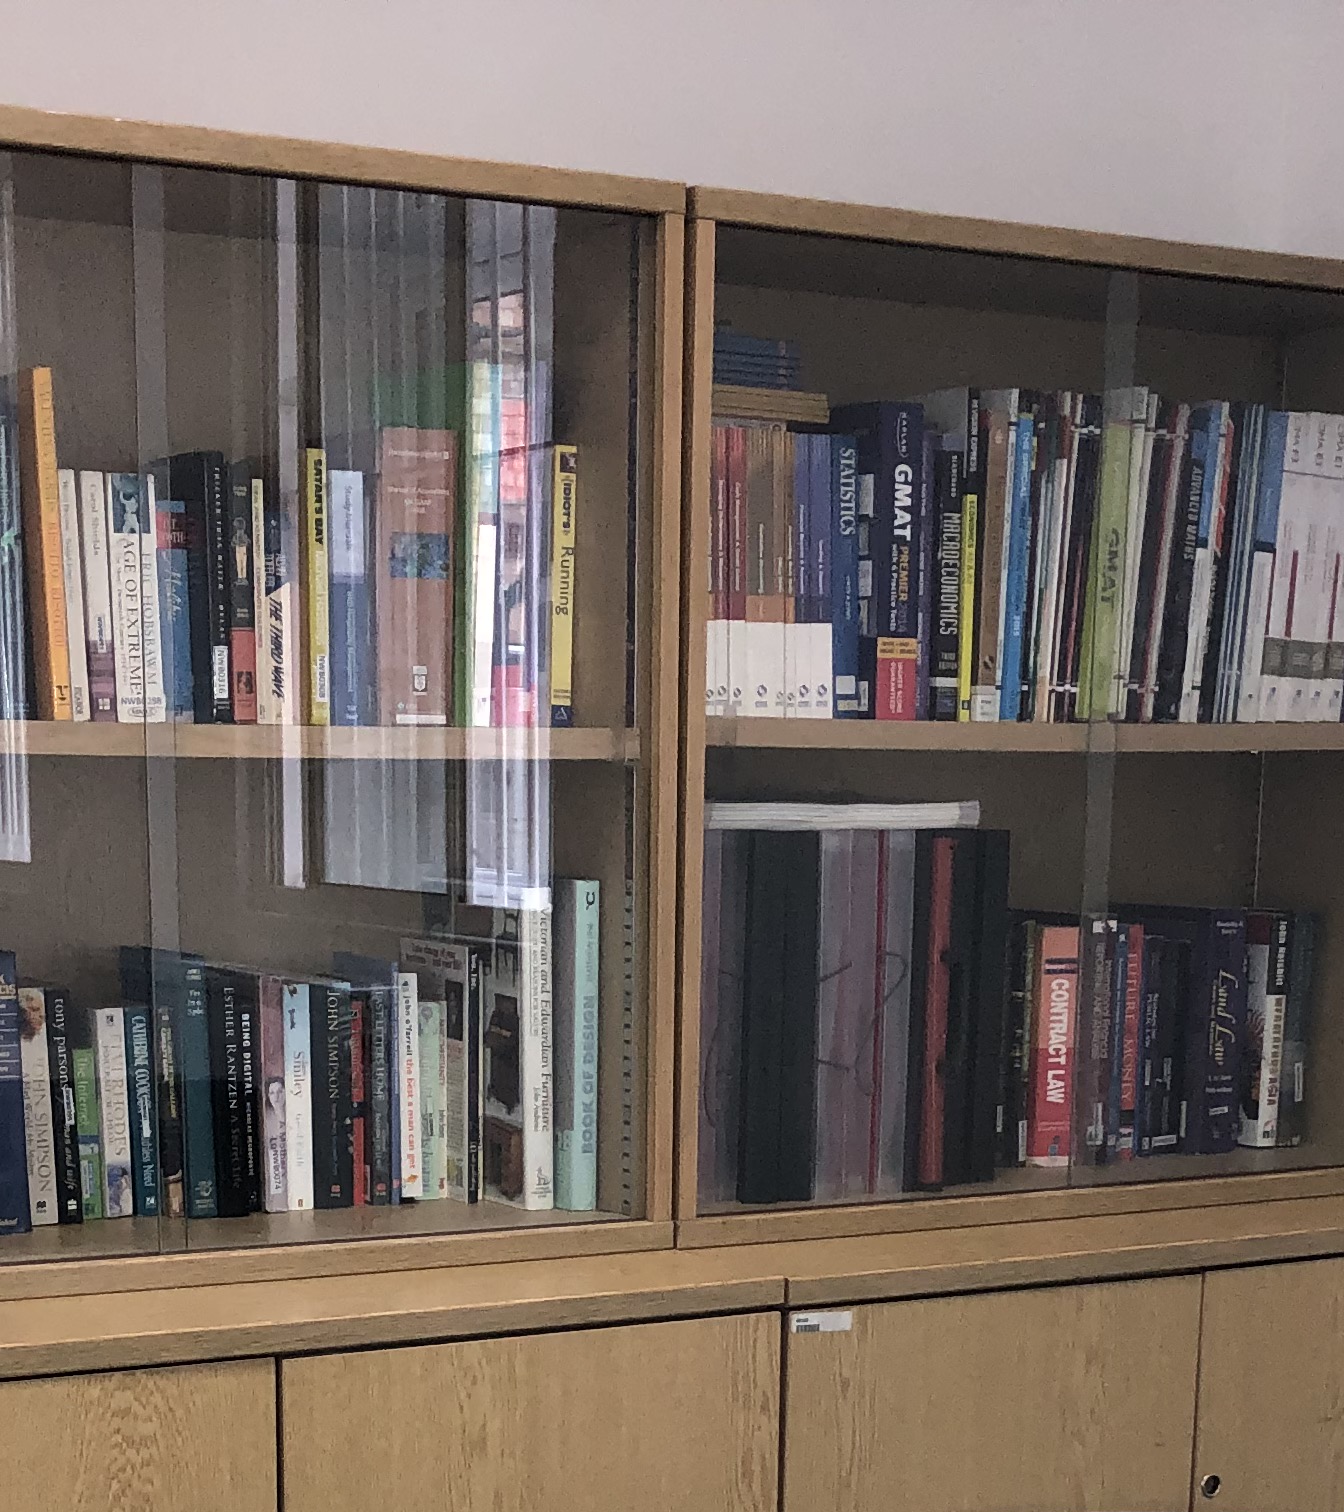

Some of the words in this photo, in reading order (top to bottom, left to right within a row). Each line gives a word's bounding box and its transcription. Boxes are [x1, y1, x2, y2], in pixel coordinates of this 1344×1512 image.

[969, 437, 978, 472] EXPRESS
[839, 447, 856, 535] STATISTICS
[893, 463, 913, 542] GMAT
[1187, 465, 1203, 521] ADVANCED
[91, 516, 102, 556] Shields
[123, 539, 136, 574] AGE
[1183, 524, 1198, 560] MATHS
[125, 579, 138, 603] OF
[141, 551, 154, 589] ERIC
[555, 546, 574, 616] Running
[890, 573, 898, 607] Practice
[898, 546, 909, 601] PREMIER
[939, 512, 961, 635] MACROECONOMICS
[1100, 527, 1120, 612] GMAT
[270, 597, 283, 625] THE
[142, 595, 158, 686] HOBSBAWM
[270, 626, 284, 663] THIRD
[271, 665, 285, 703] WAVE
[539, 909, 551, 966] Victorian
[1277, 920, 1287, 944] John
[540, 969, 551, 994] and
[1125, 953, 1138, 1022] FUTURE
[1276, 947, 1287, 986] Naisbitt
[52, 998, 67, 1030] tony
[223, 987, 235, 1037] ESTHER
[326, 990, 340, 1031] JOHN
[1217, 969, 1239, 1024] Land
[242, 1013, 251, 1046] BEING
[540, 1000, 551, 1068] Edwardian
[582, 996, 595, 1065] DESIGN
[1047, 978, 1069, 1065] CONTRACT
[1214, 1024, 1236, 1066] Law
[32, 1057, 47, 1105] JOHN
[54, 1036, 70, 1089] parsons
[75, 1057, 88, 1075] The
[225, 1044, 238, 1109] RANTZEN
[242, 1052, 252, 1096] DIGITAL
[291, 1050, 306, 1098] Smiley
[327, 1035, 340, 1099] SIMPSON
[406, 1059, 414, 1075] the
[1121, 1039, 1135, 1102] MONEY
[77, 1080, 91, 1127] Internet
[131, 1015, 149, 1066] CATHERINE
[143, 1165, 155, 1186] Need
[407, 1077, 415, 1098] best
[540, 1073, 551, 1133] Furniture
[1046, 1070, 1066, 1103] LAW
[1267, 1078, 1278, 1106] ASIA
[111, 1078, 127, 1156] RHODES
[581, 1101, 594, 1154] BOOK
[36, 1113, 52, 1192] SIMPSON
[64, 1147, 74, 1167] and
[408, 1153, 417, 1168] get
[66, 1169, 77, 1191] wife
